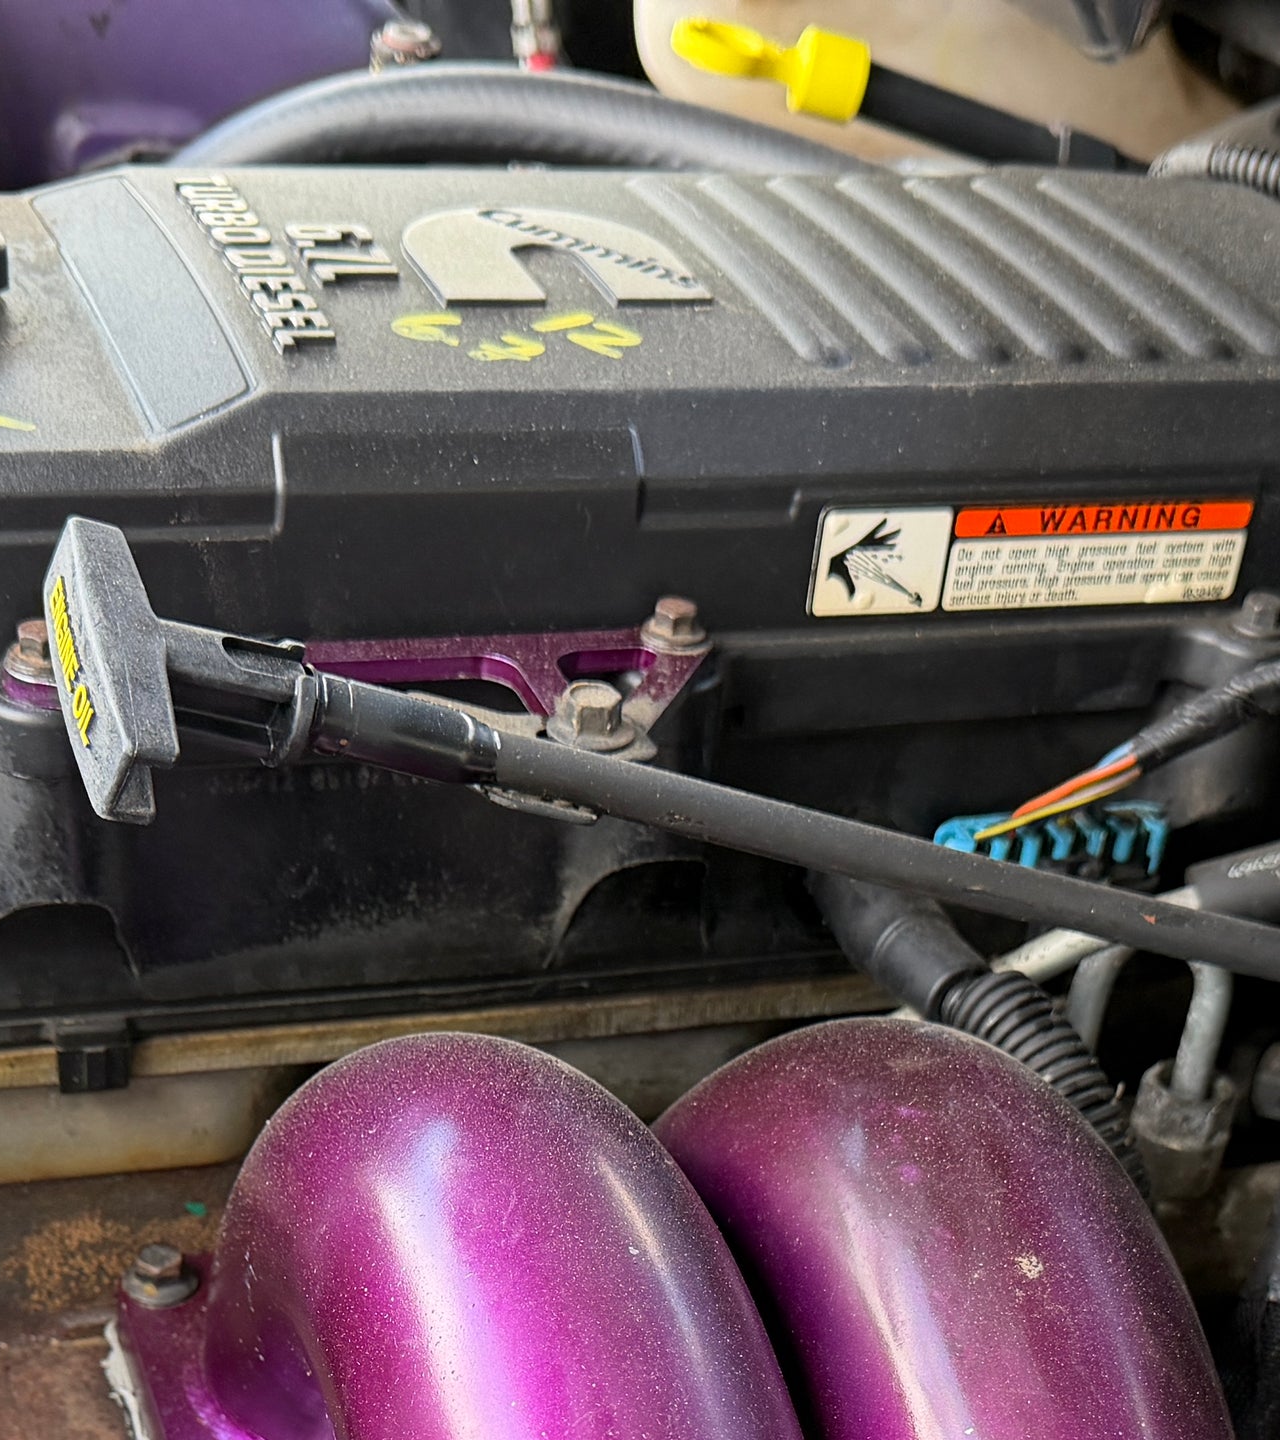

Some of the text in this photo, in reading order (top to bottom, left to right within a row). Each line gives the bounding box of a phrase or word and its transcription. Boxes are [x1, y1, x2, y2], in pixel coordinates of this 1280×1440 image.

[285, 223, 400, 283] 6.7L
[477, 208, 703, 290] Cummins
[174, 174, 336, 354] TURBO DIESEL
[1039, 506, 1202, 533] WARNING
[957, 539, 1236, 561] Do not open high pressure fuel system with
[954, 562, 994, 578] engine
[1057, 559, 1095, 575] Engine
[1102, 556, 1155, 572] operation
[1162, 556, 1202, 568] causes
[1209, 554, 1233, 569] high
[952, 578, 974, 591] fuel
[1034, 575, 1060, 589] High
[1063, 573, 1111, 588] pressure
[1115, 571, 1136, 584] fuel
[1139, 571, 1171, 586] spray
[1198, 569, 1229, 582] cause
[949, 593, 991, 606] serious
[994, 592, 1026, 607] injury
[1029, 592, 1041, 603] or
[49, 575, 98, 747] ENGINE OIL
